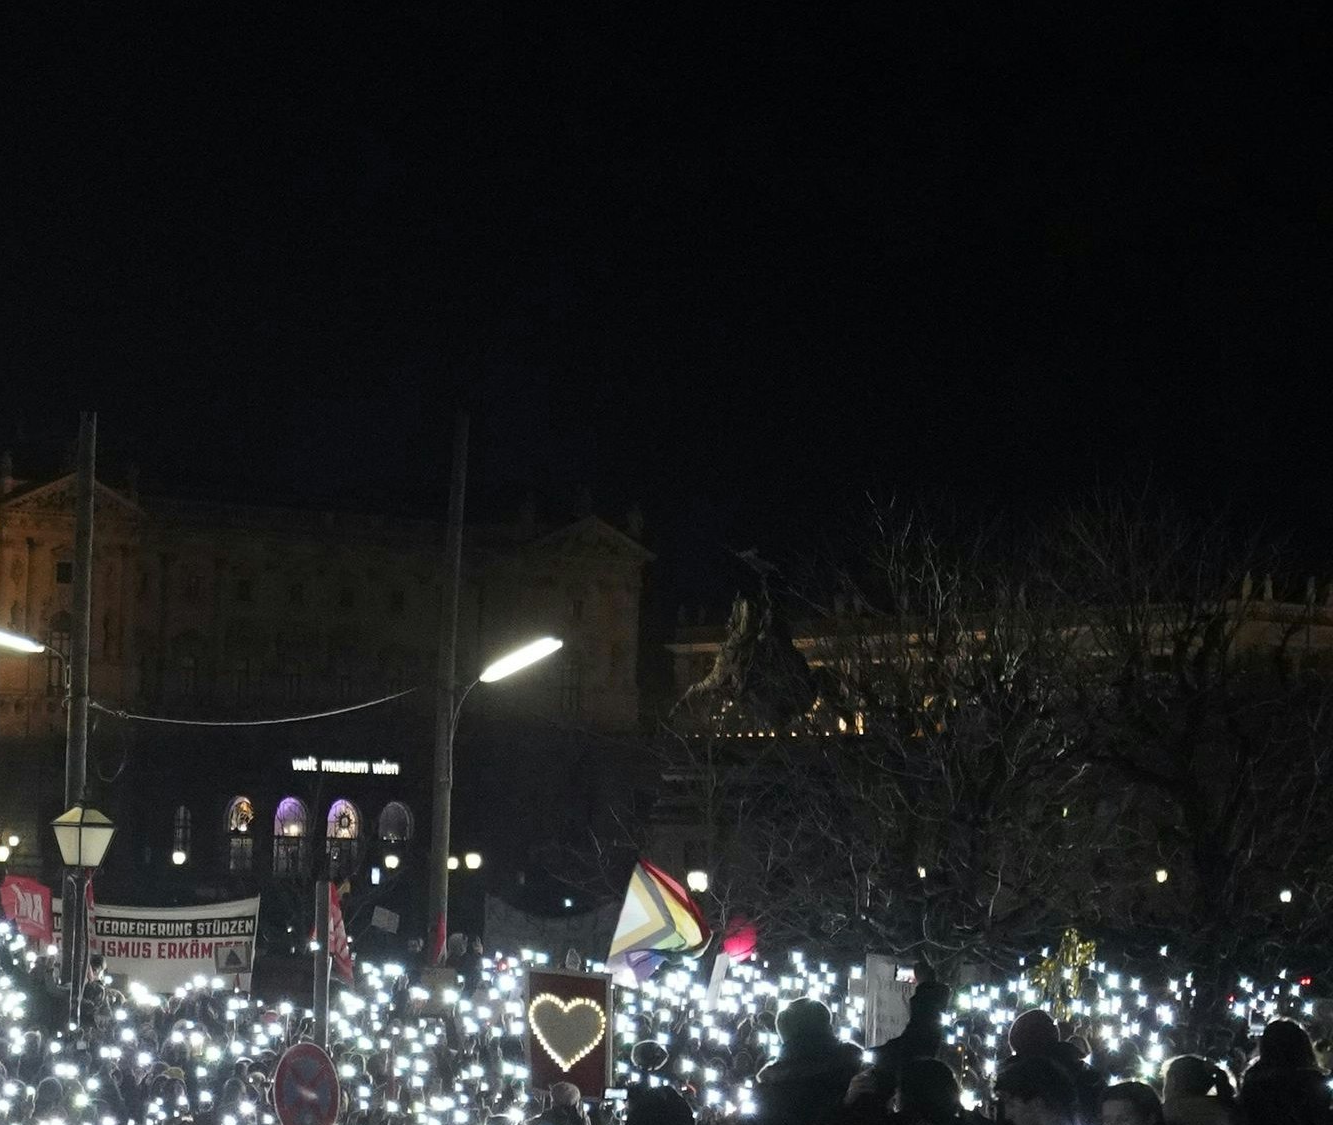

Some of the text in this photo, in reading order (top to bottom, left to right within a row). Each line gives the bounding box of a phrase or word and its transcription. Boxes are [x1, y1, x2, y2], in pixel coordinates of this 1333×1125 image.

[292, 756, 400, 776] welt museum wien
[196, 919, 254, 935] STÜRZEN
